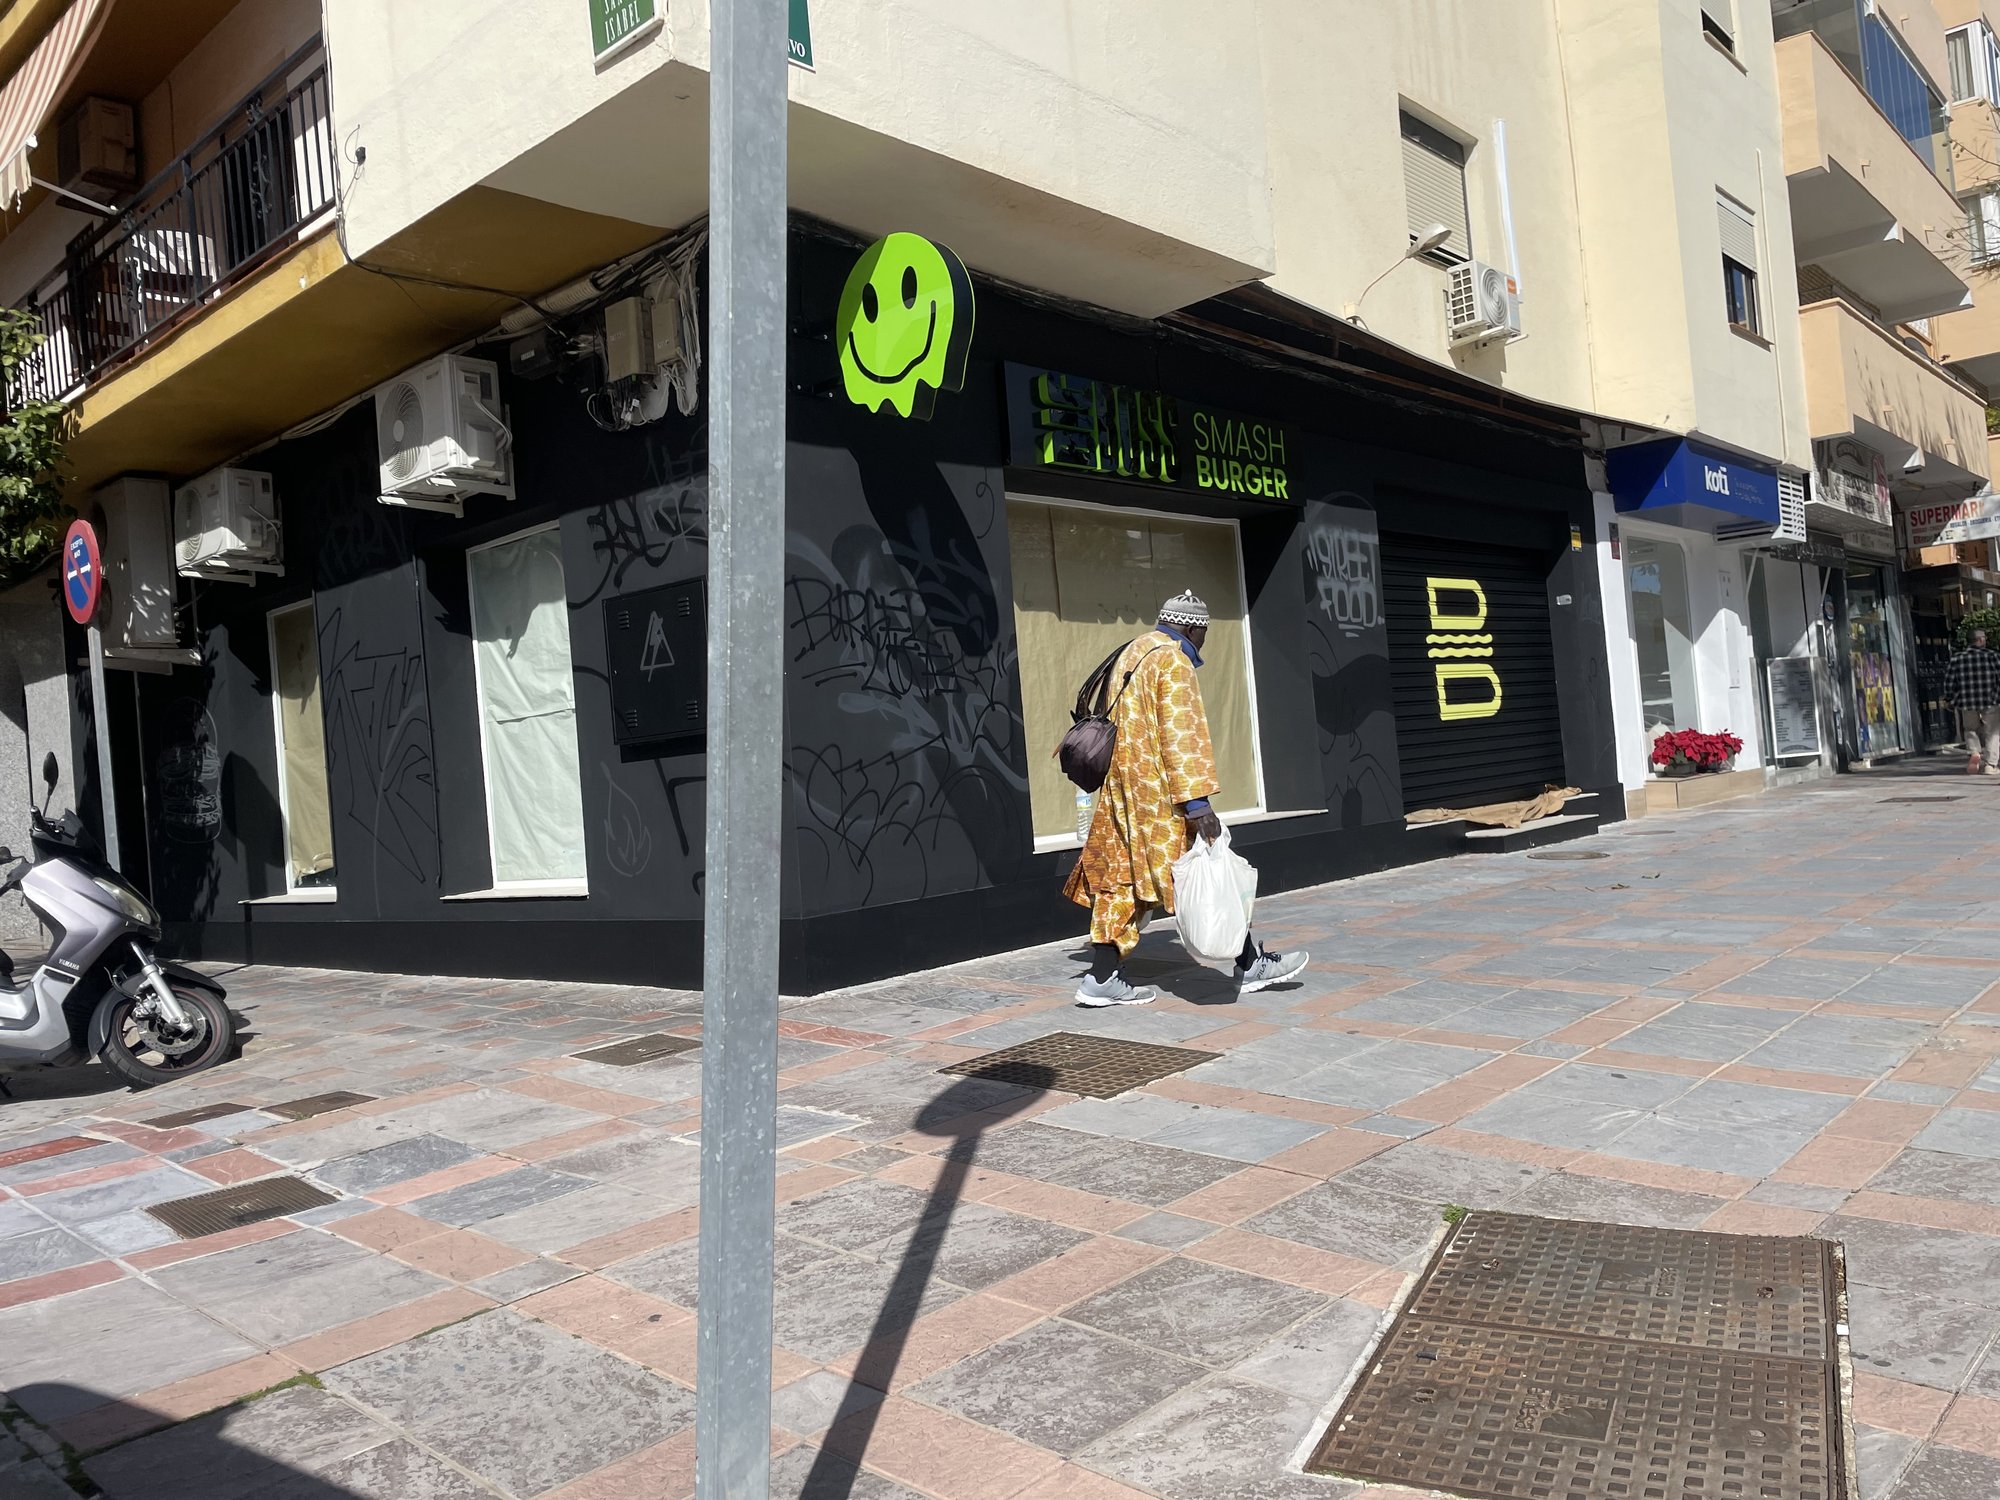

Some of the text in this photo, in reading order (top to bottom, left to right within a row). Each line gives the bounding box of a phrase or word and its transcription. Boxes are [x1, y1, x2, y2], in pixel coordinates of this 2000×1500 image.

[604, 0, 641, 44] ISABEL
[1193, 412, 1287, 465] SMASH
[1195, 455, 1289, 500] BURGER
[1704, 464, 1731, 496] koti
[58, 957, 80, 969] YAMAHA
